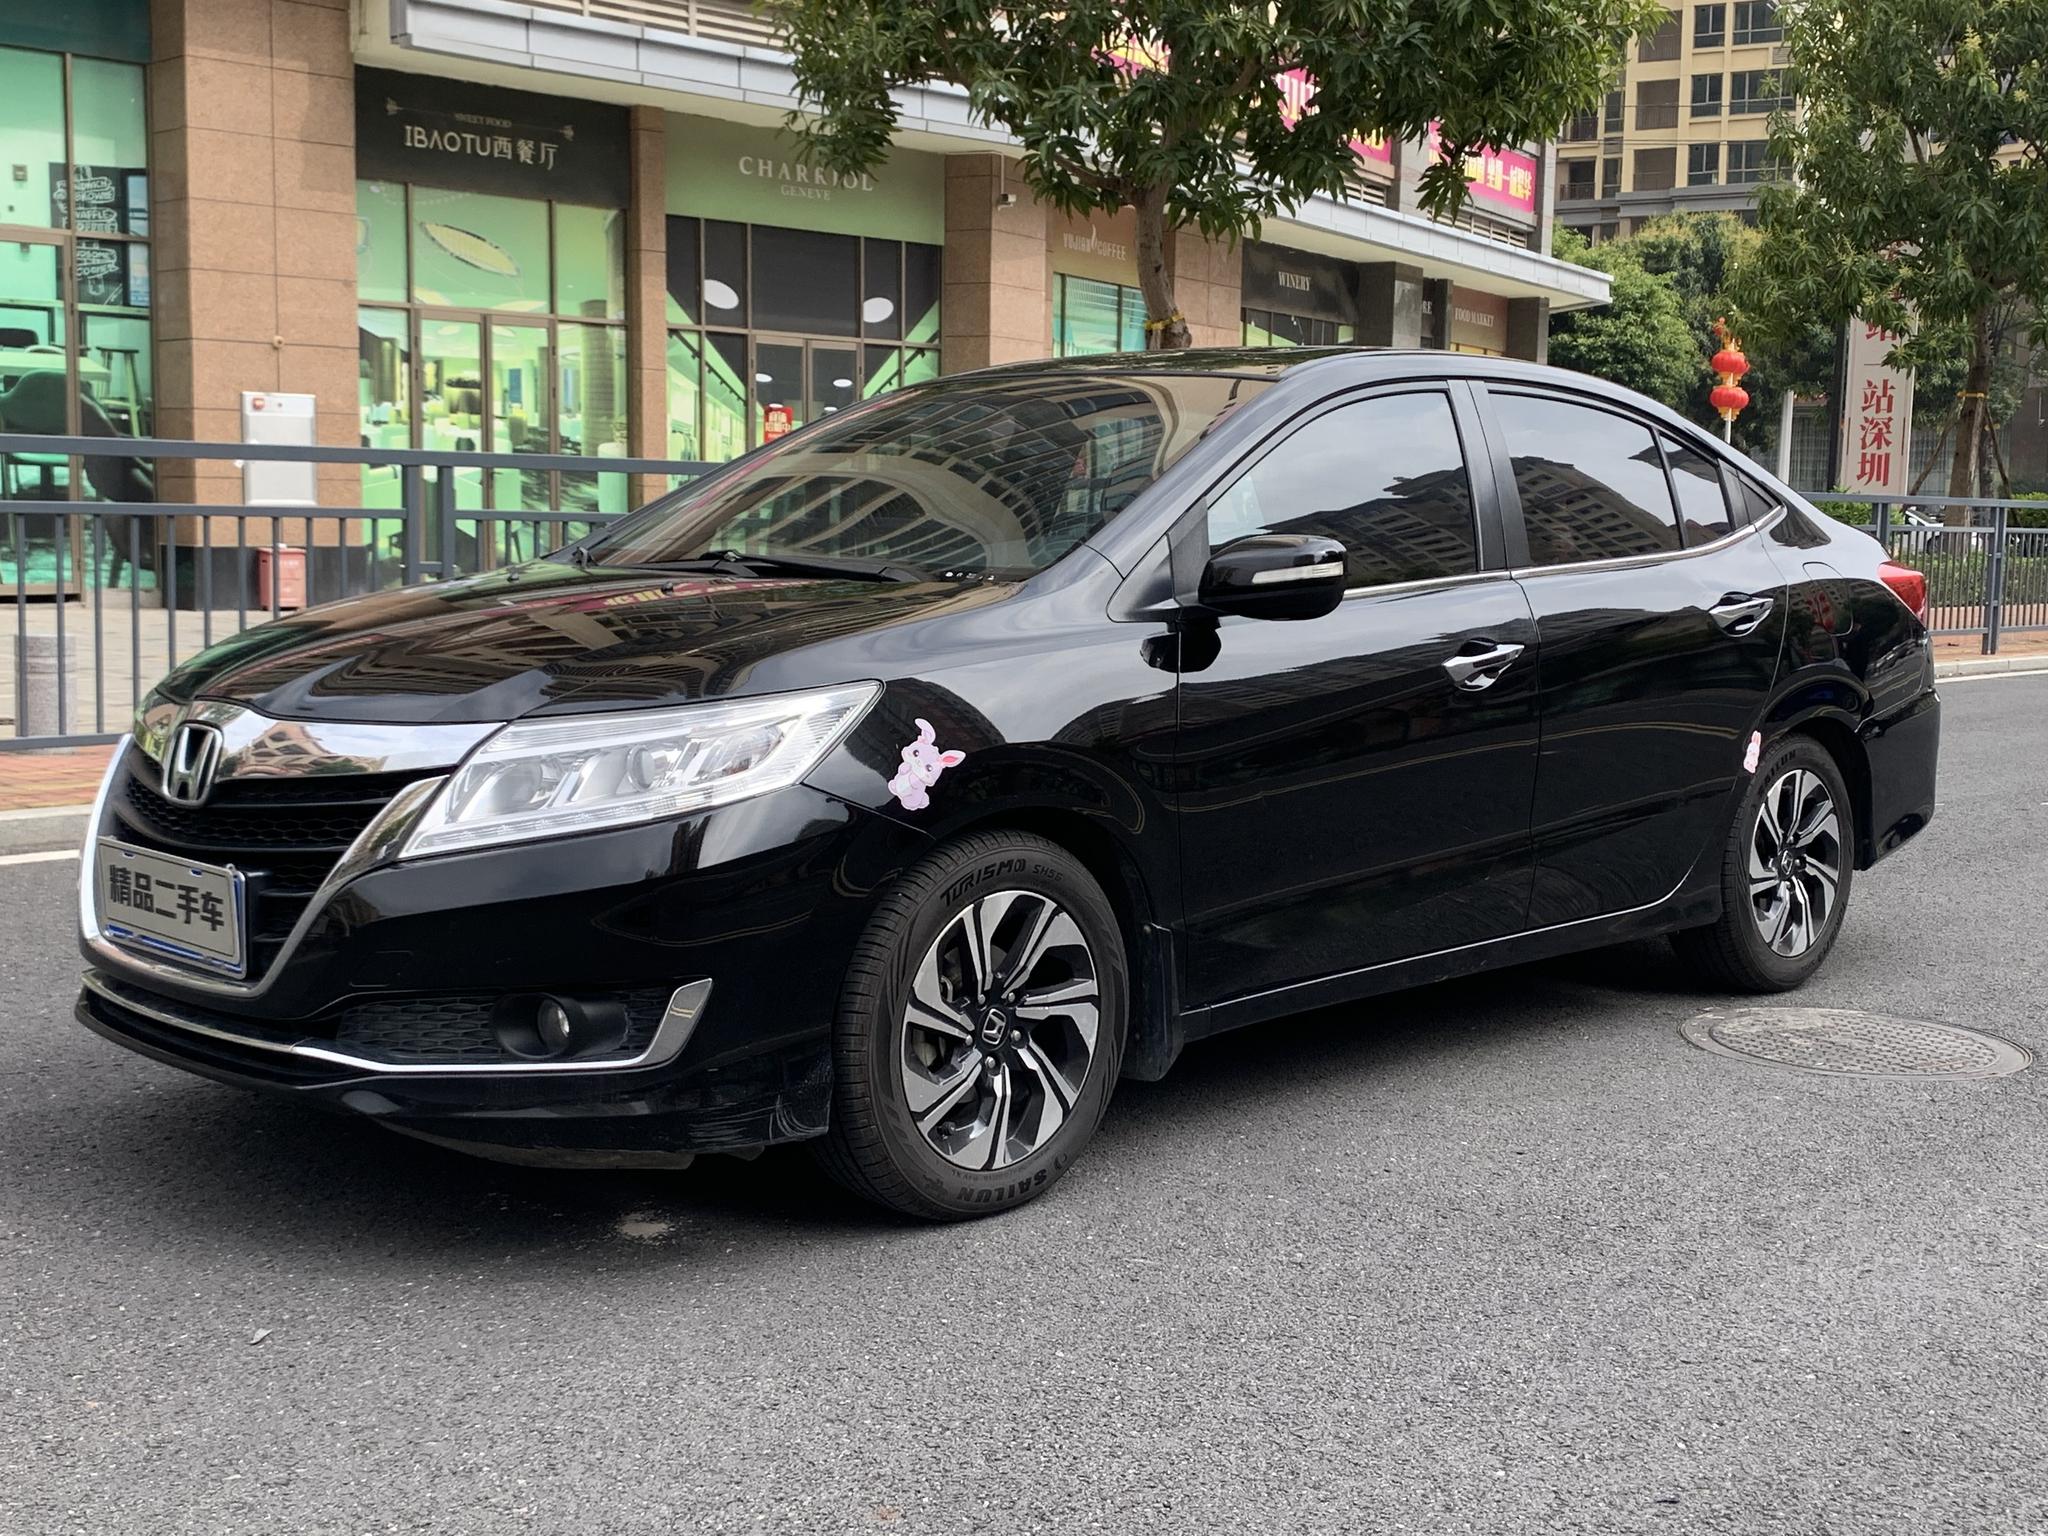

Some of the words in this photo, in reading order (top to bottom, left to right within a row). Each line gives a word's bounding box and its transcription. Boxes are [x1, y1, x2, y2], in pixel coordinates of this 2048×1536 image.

[1279, 271, 1311, 291] WINERY
[1455, 307, 1470, 322] FOOD
[110, 865, 225, 932] 精品二手车
[940, 858, 1026, 906] TURISMO
[956, 1169, 1048, 1204] SAILUN
